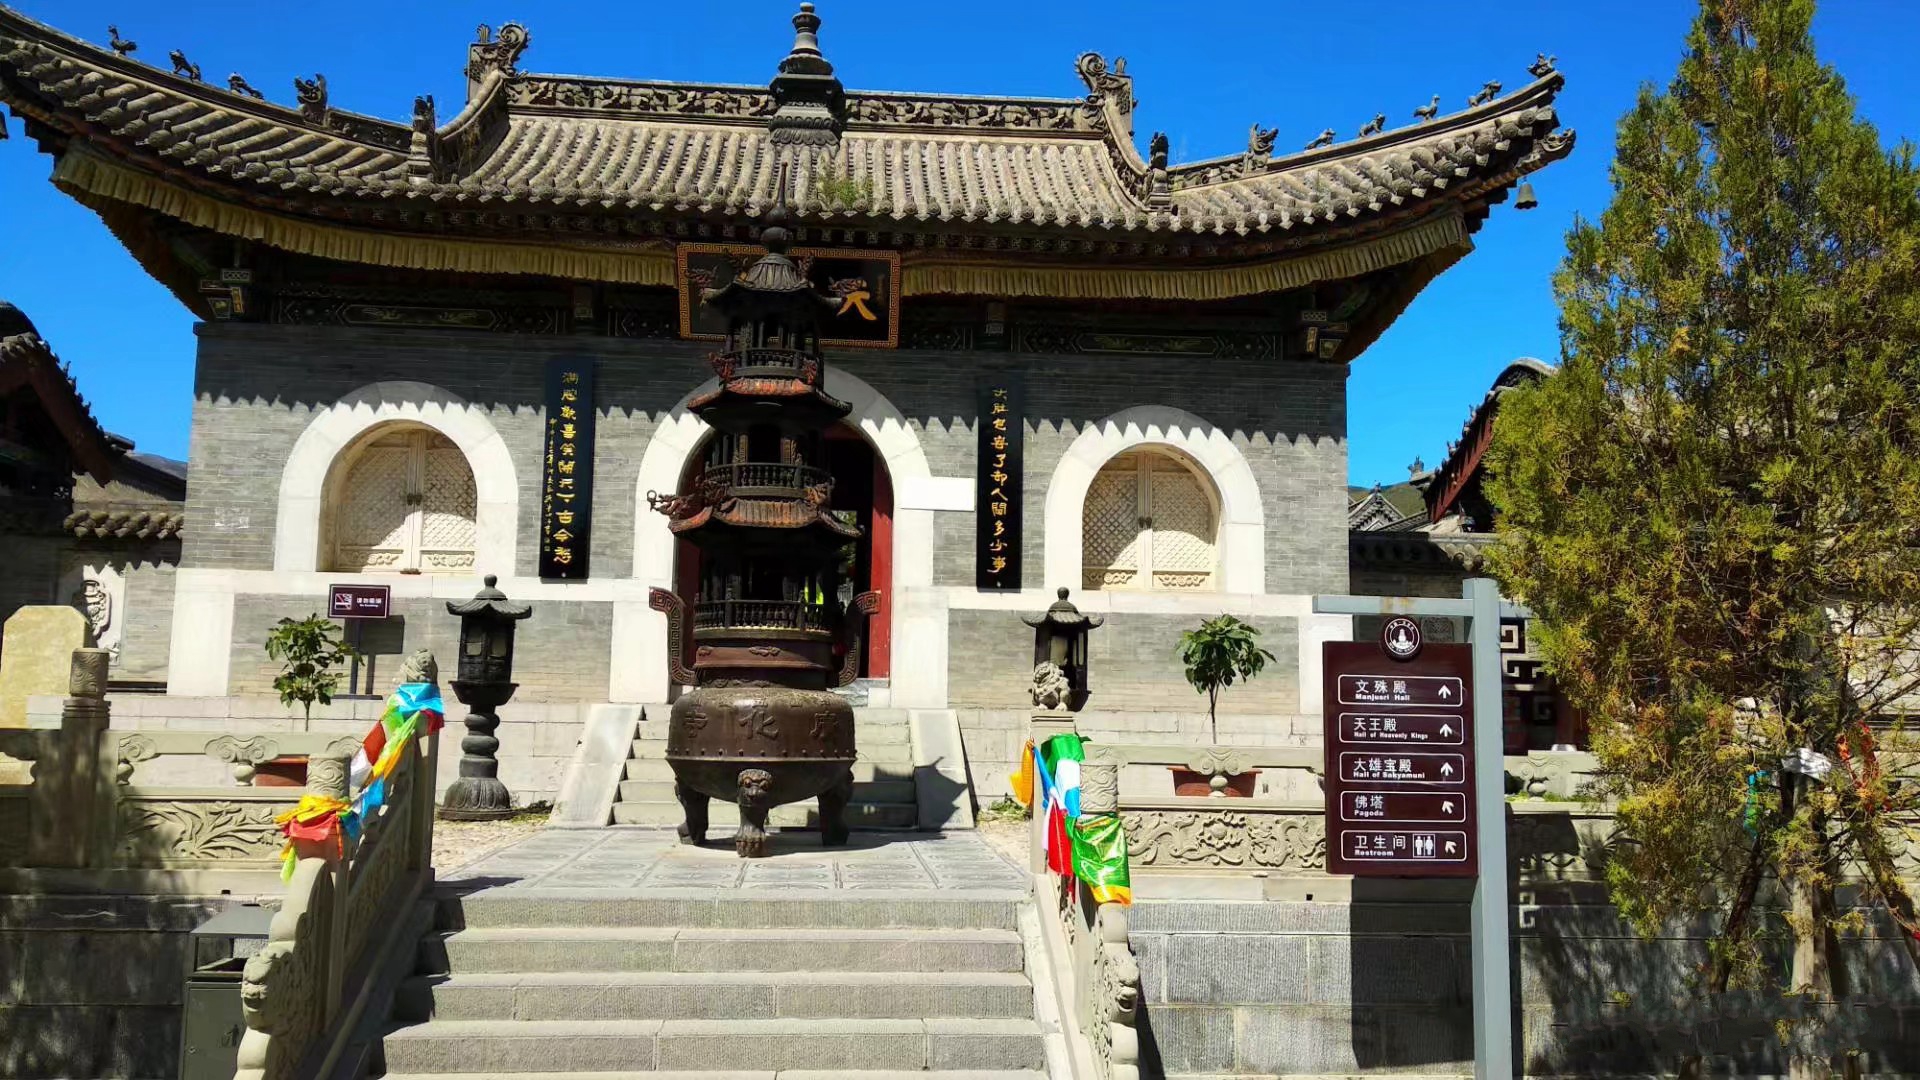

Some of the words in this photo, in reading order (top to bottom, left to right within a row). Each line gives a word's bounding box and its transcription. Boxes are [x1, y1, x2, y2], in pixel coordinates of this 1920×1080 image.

[1355, 679, 1407, 694] 文殊殿
[1353, 717, 1397, 732] 天王殿
[1379, 732, 1408, 740] Heavenly
[1410, 732, 1429, 740] Kings
[1353, 757, 1412, 773] 大雄宝殿
[1382, 772, 1426, 780] Sakyamuni
[1355, 795, 1384, 809] 佛塔
[1354, 809, 1384, 817] Pagoda
[1354, 834, 1407, 850] 卫生间
